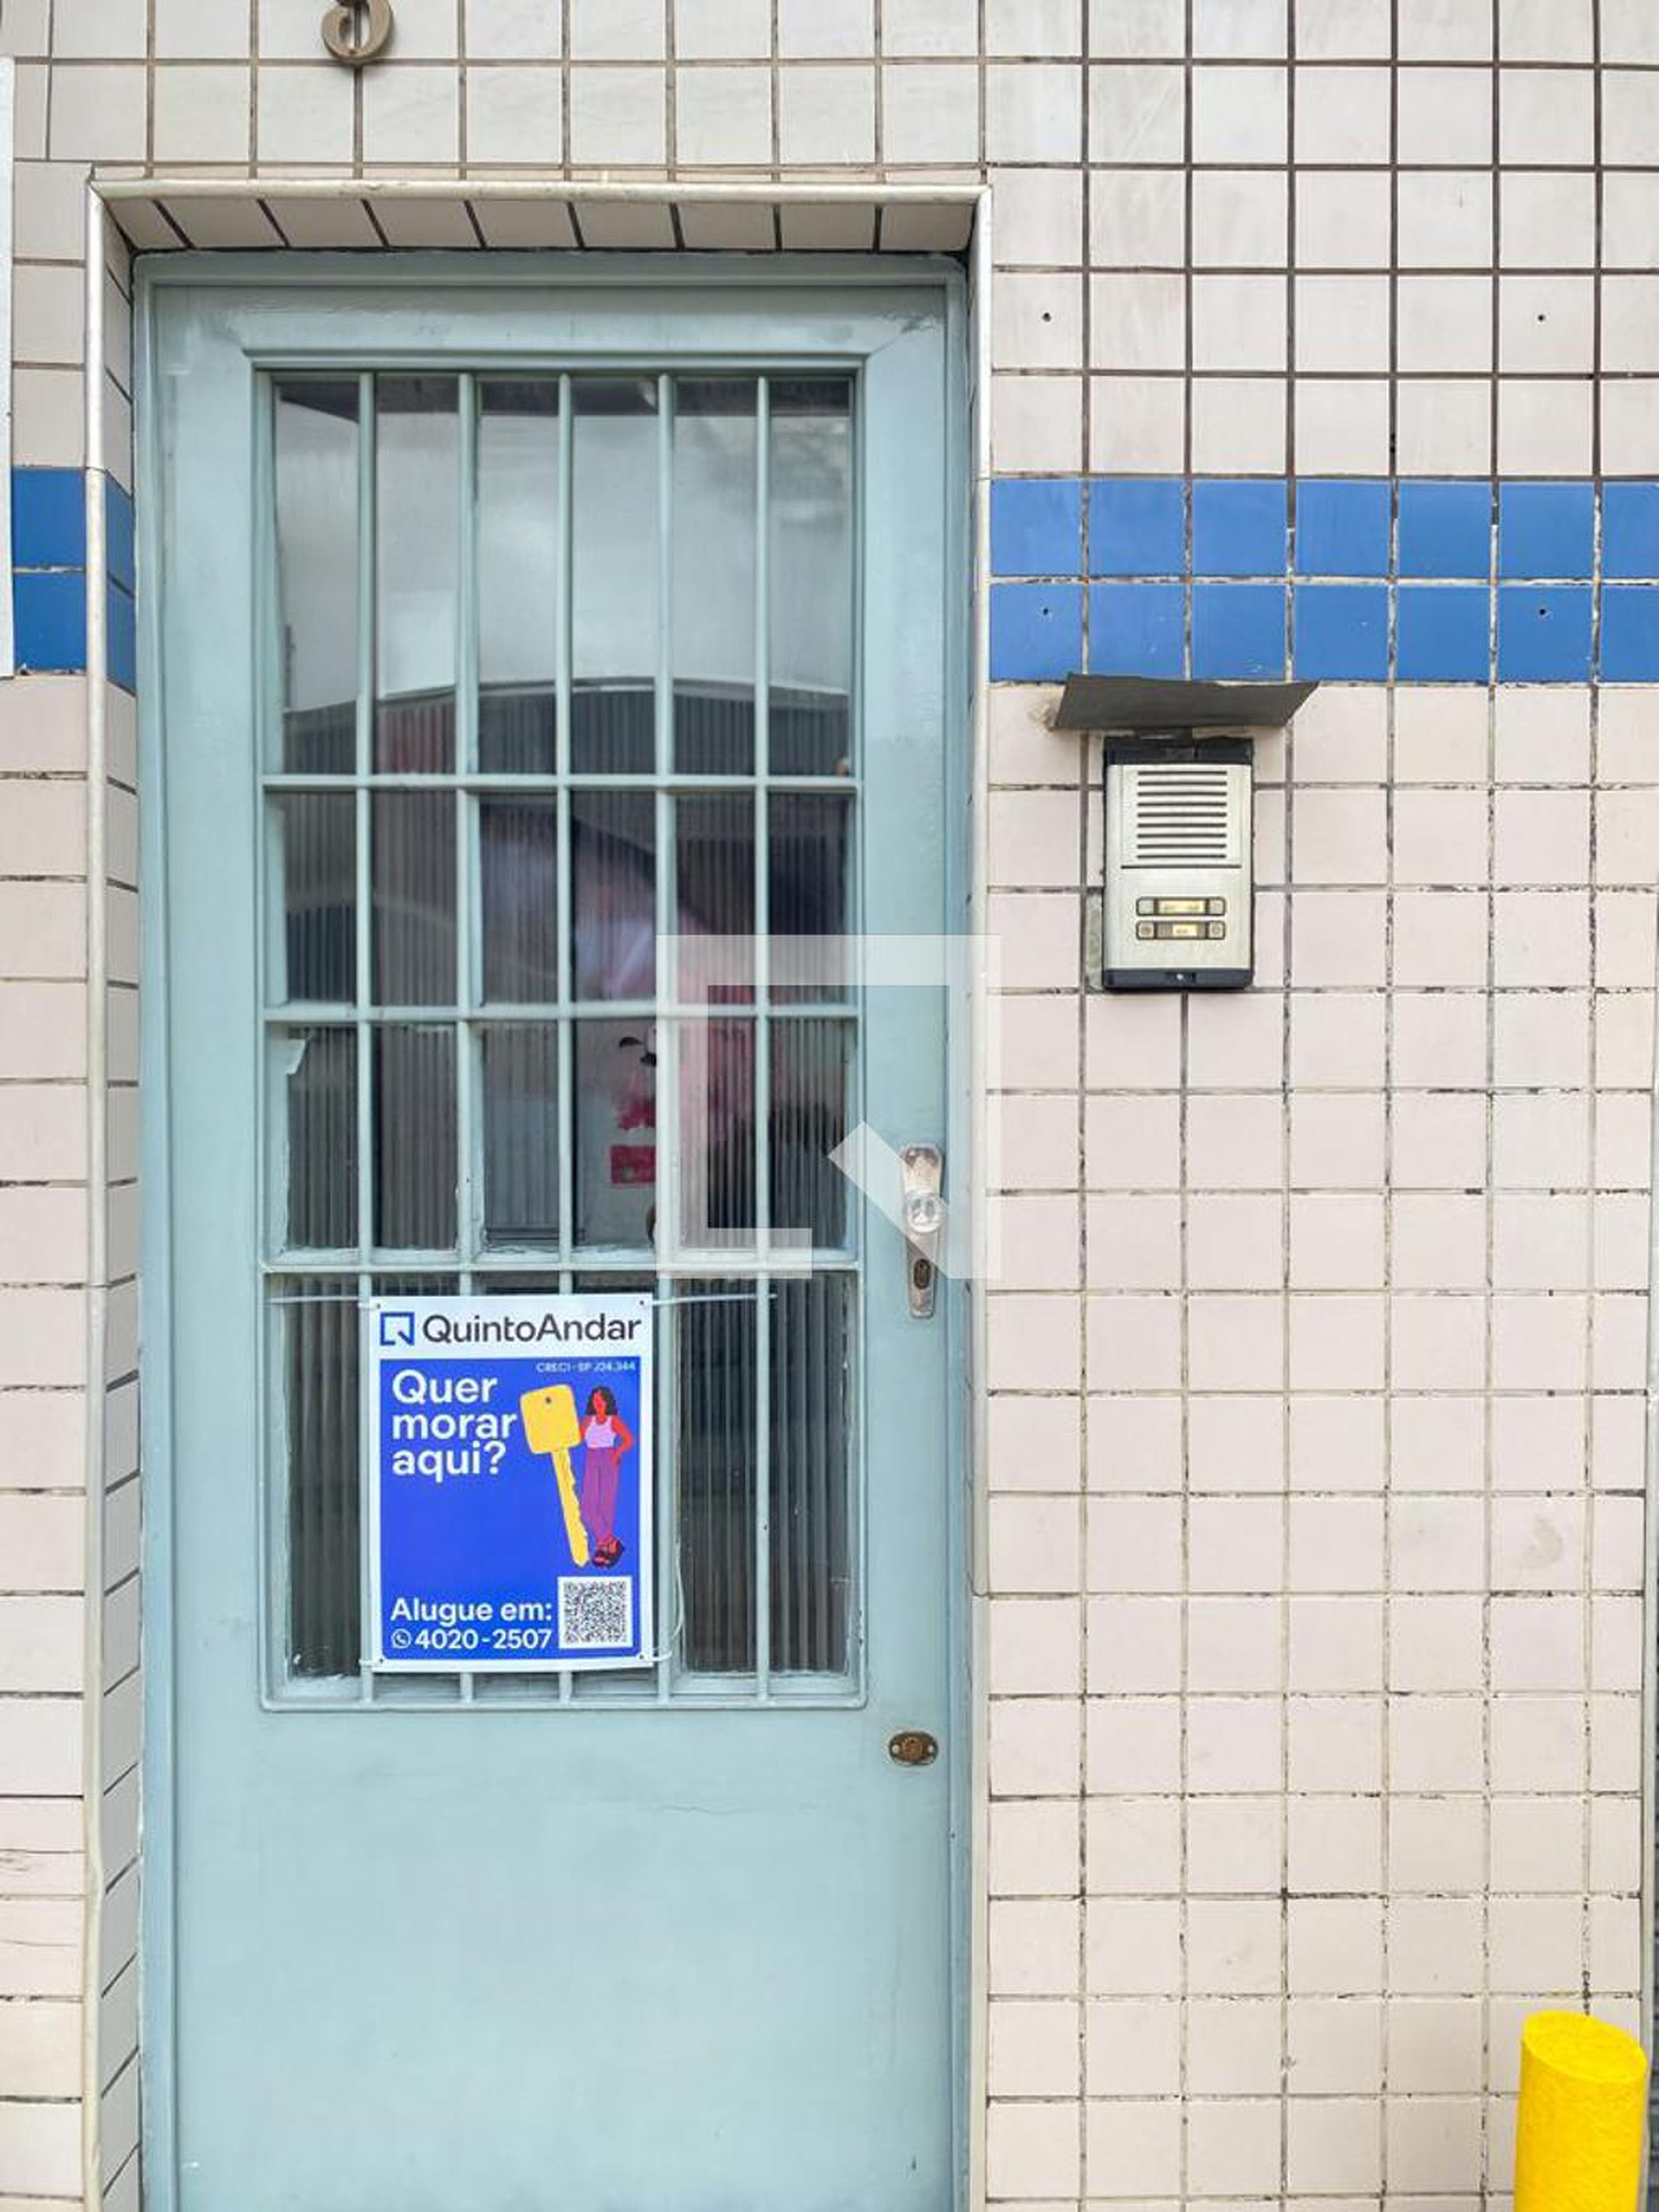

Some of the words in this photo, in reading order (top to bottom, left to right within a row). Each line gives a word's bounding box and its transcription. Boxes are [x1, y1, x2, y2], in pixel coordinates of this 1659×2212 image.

[423, 1314, 641, 1343] QuintoAndar
[393, 1369, 497, 1405] Quer
[393, 1413, 517, 1439] morar
[393, 1441, 506, 1483] aqui?
[391, 1598, 493, 1627] Alugue
[500, 1603, 552, 1621] em:
[415, 1629, 552, 1649] 4020-2507
